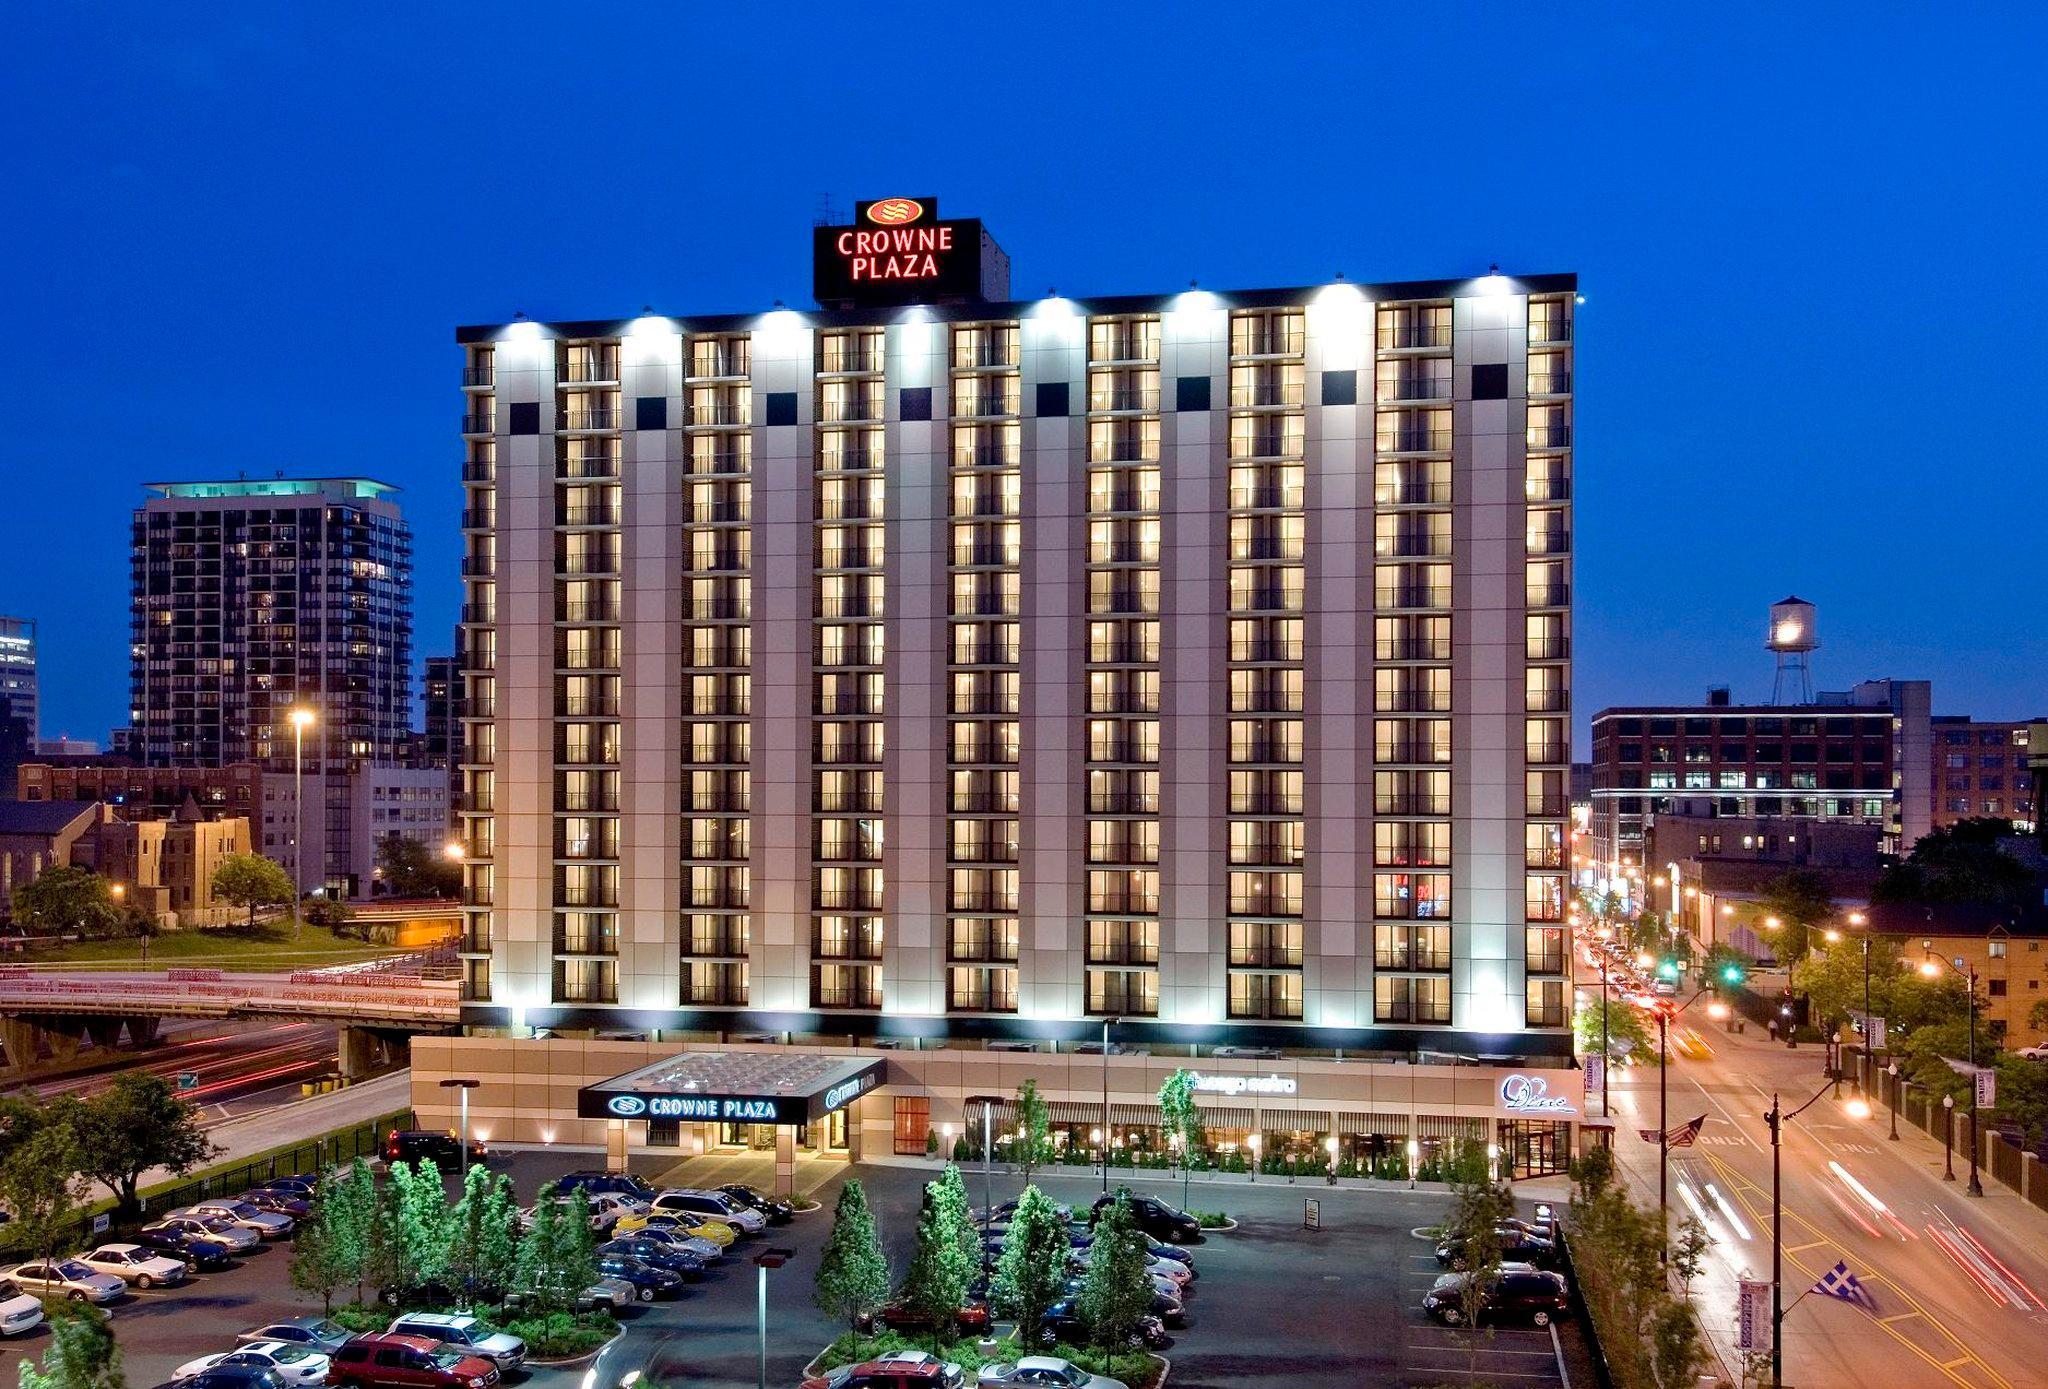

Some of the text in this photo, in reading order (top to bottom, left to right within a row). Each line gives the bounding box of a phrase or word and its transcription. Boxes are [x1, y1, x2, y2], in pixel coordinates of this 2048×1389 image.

[838, 227, 953, 255] CROWNE
[853, 254, 938, 280] PLAZA
[649, 1097, 777, 1119] CROWNE PLAZA
[1700, 1135, 1747, 1146] ONLY
